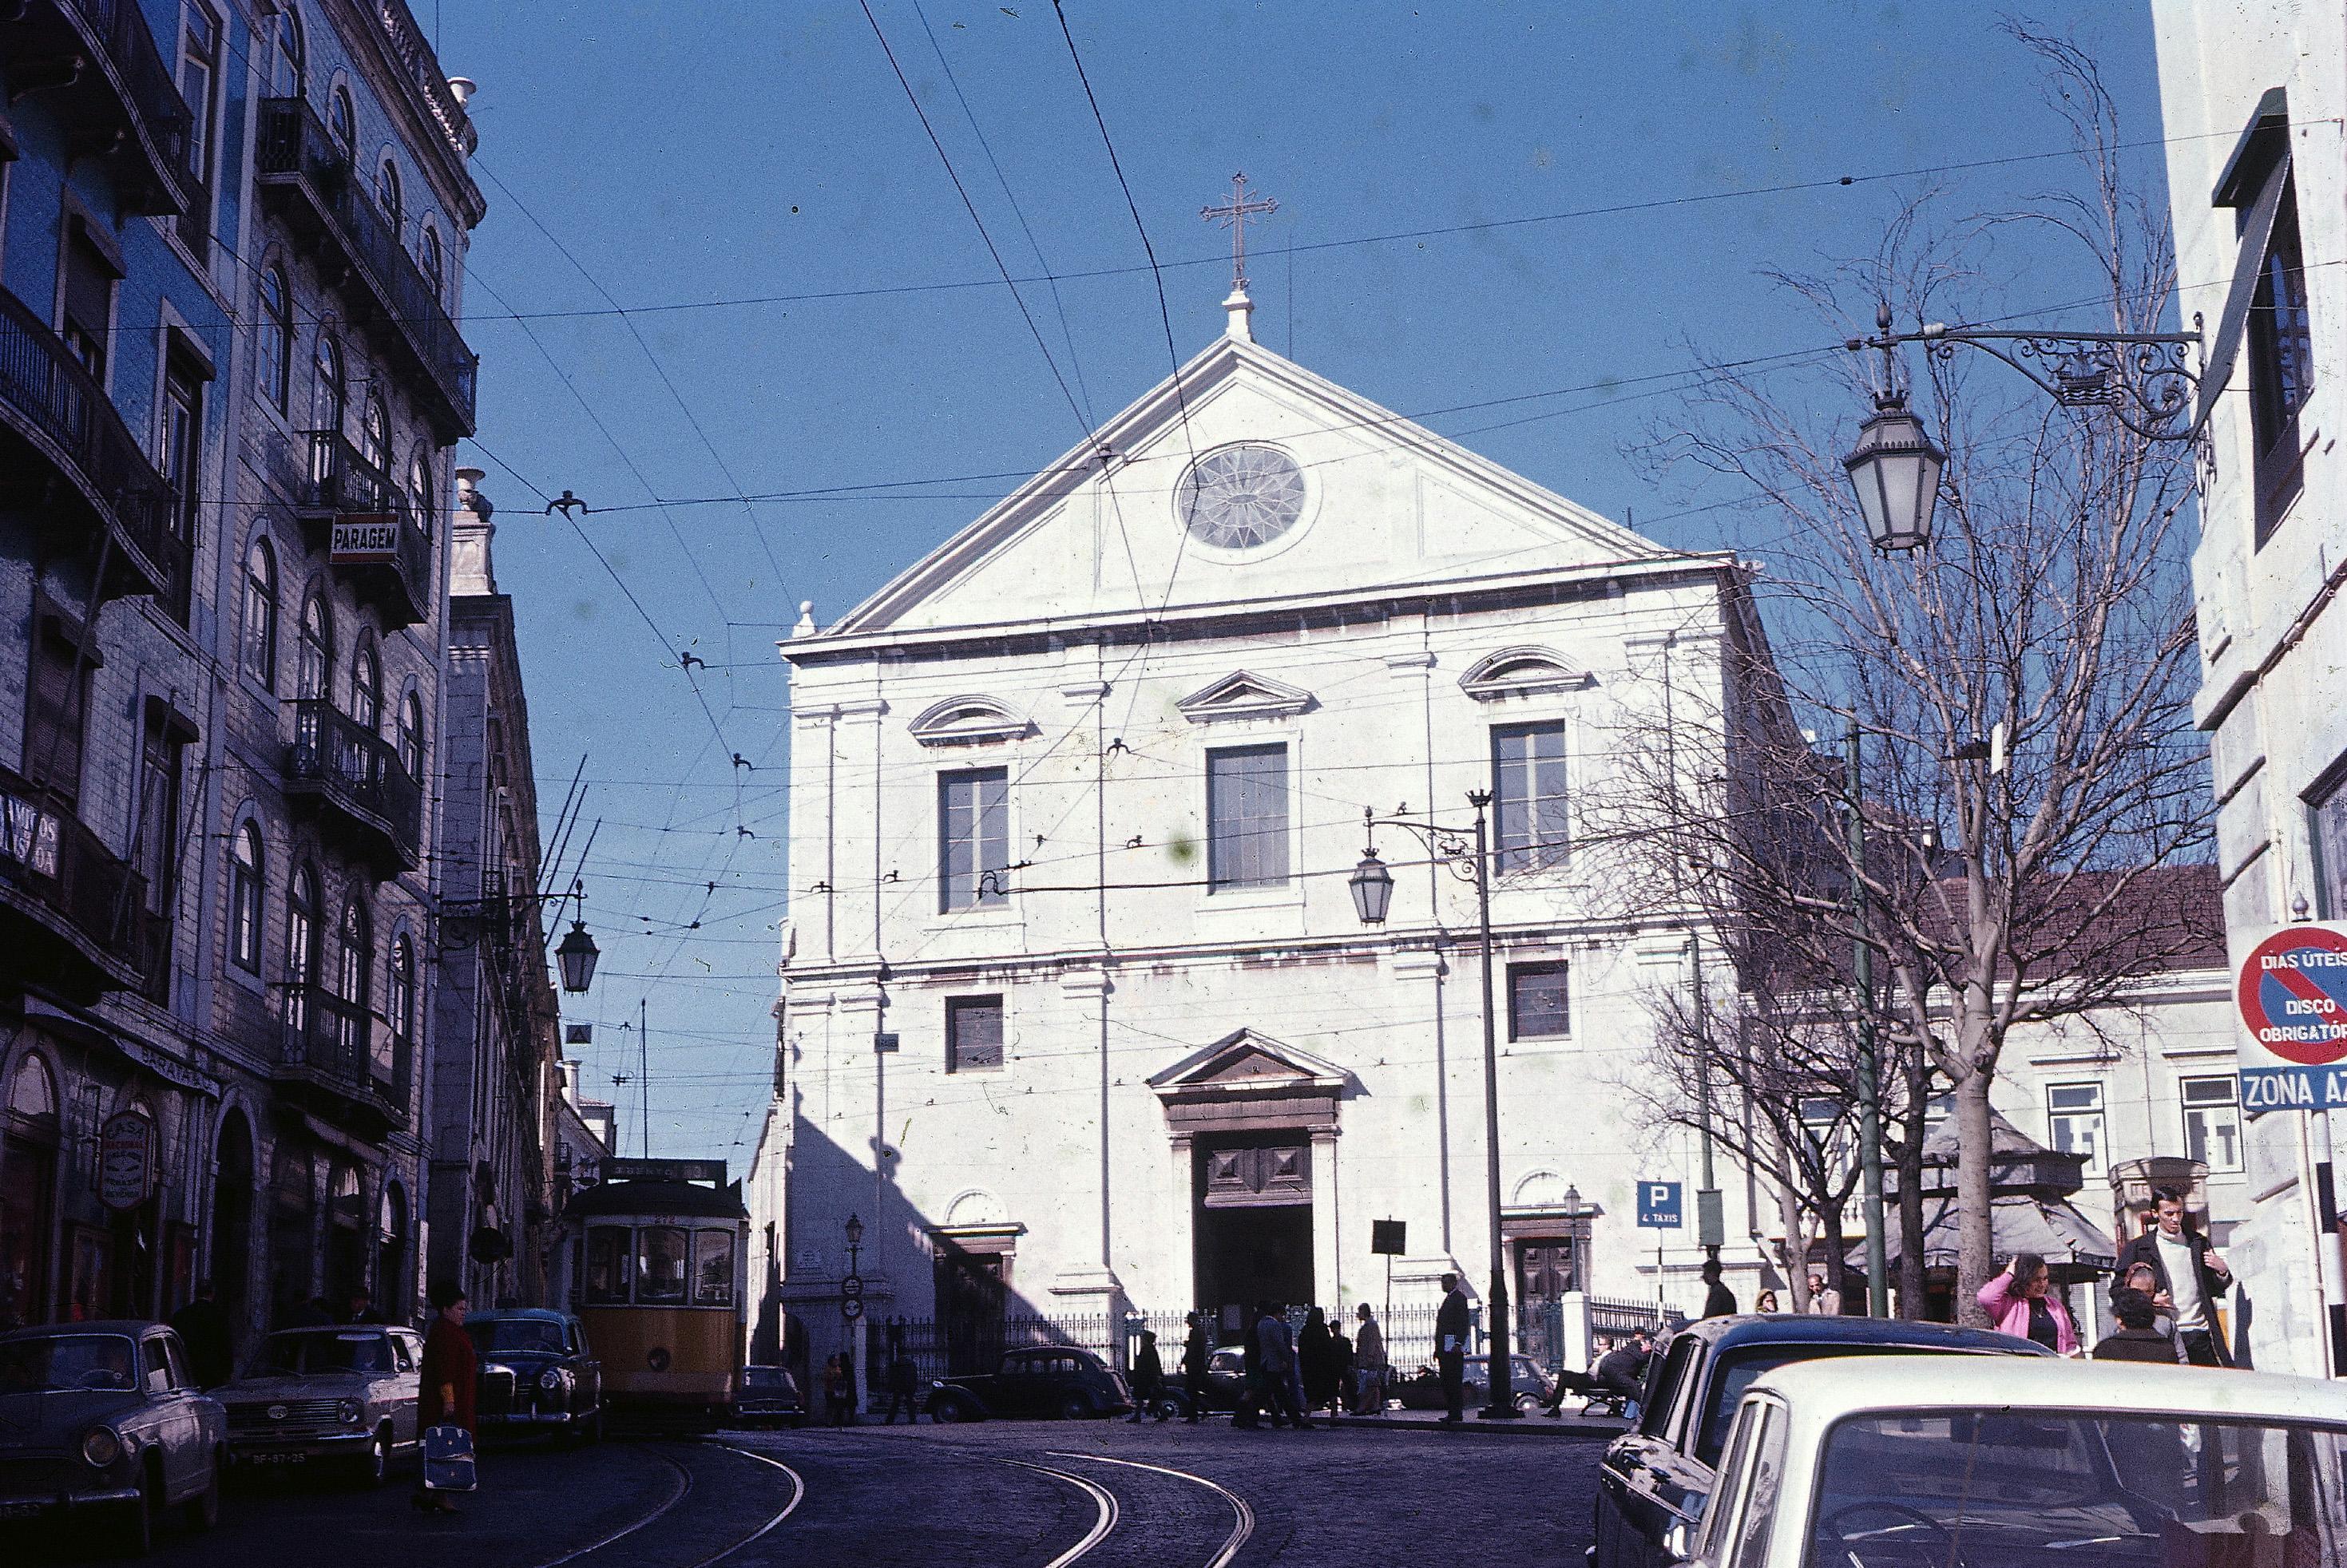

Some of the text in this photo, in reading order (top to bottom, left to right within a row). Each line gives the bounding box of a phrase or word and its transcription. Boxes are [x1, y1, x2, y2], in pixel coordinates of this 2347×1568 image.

[333, 528, 396, 549] PARAGEM
[2261, 950, 2298, 970] DIAS
[2286, 999, 2336, 1016] DISCO
[2243, 1073, 2314, 1107] ZONA
[105, 1122, 145, 1140] CASA
[1650, 1186, 1670, 1208] P
[1652, 1213, 1679, 1223] TAXIS
